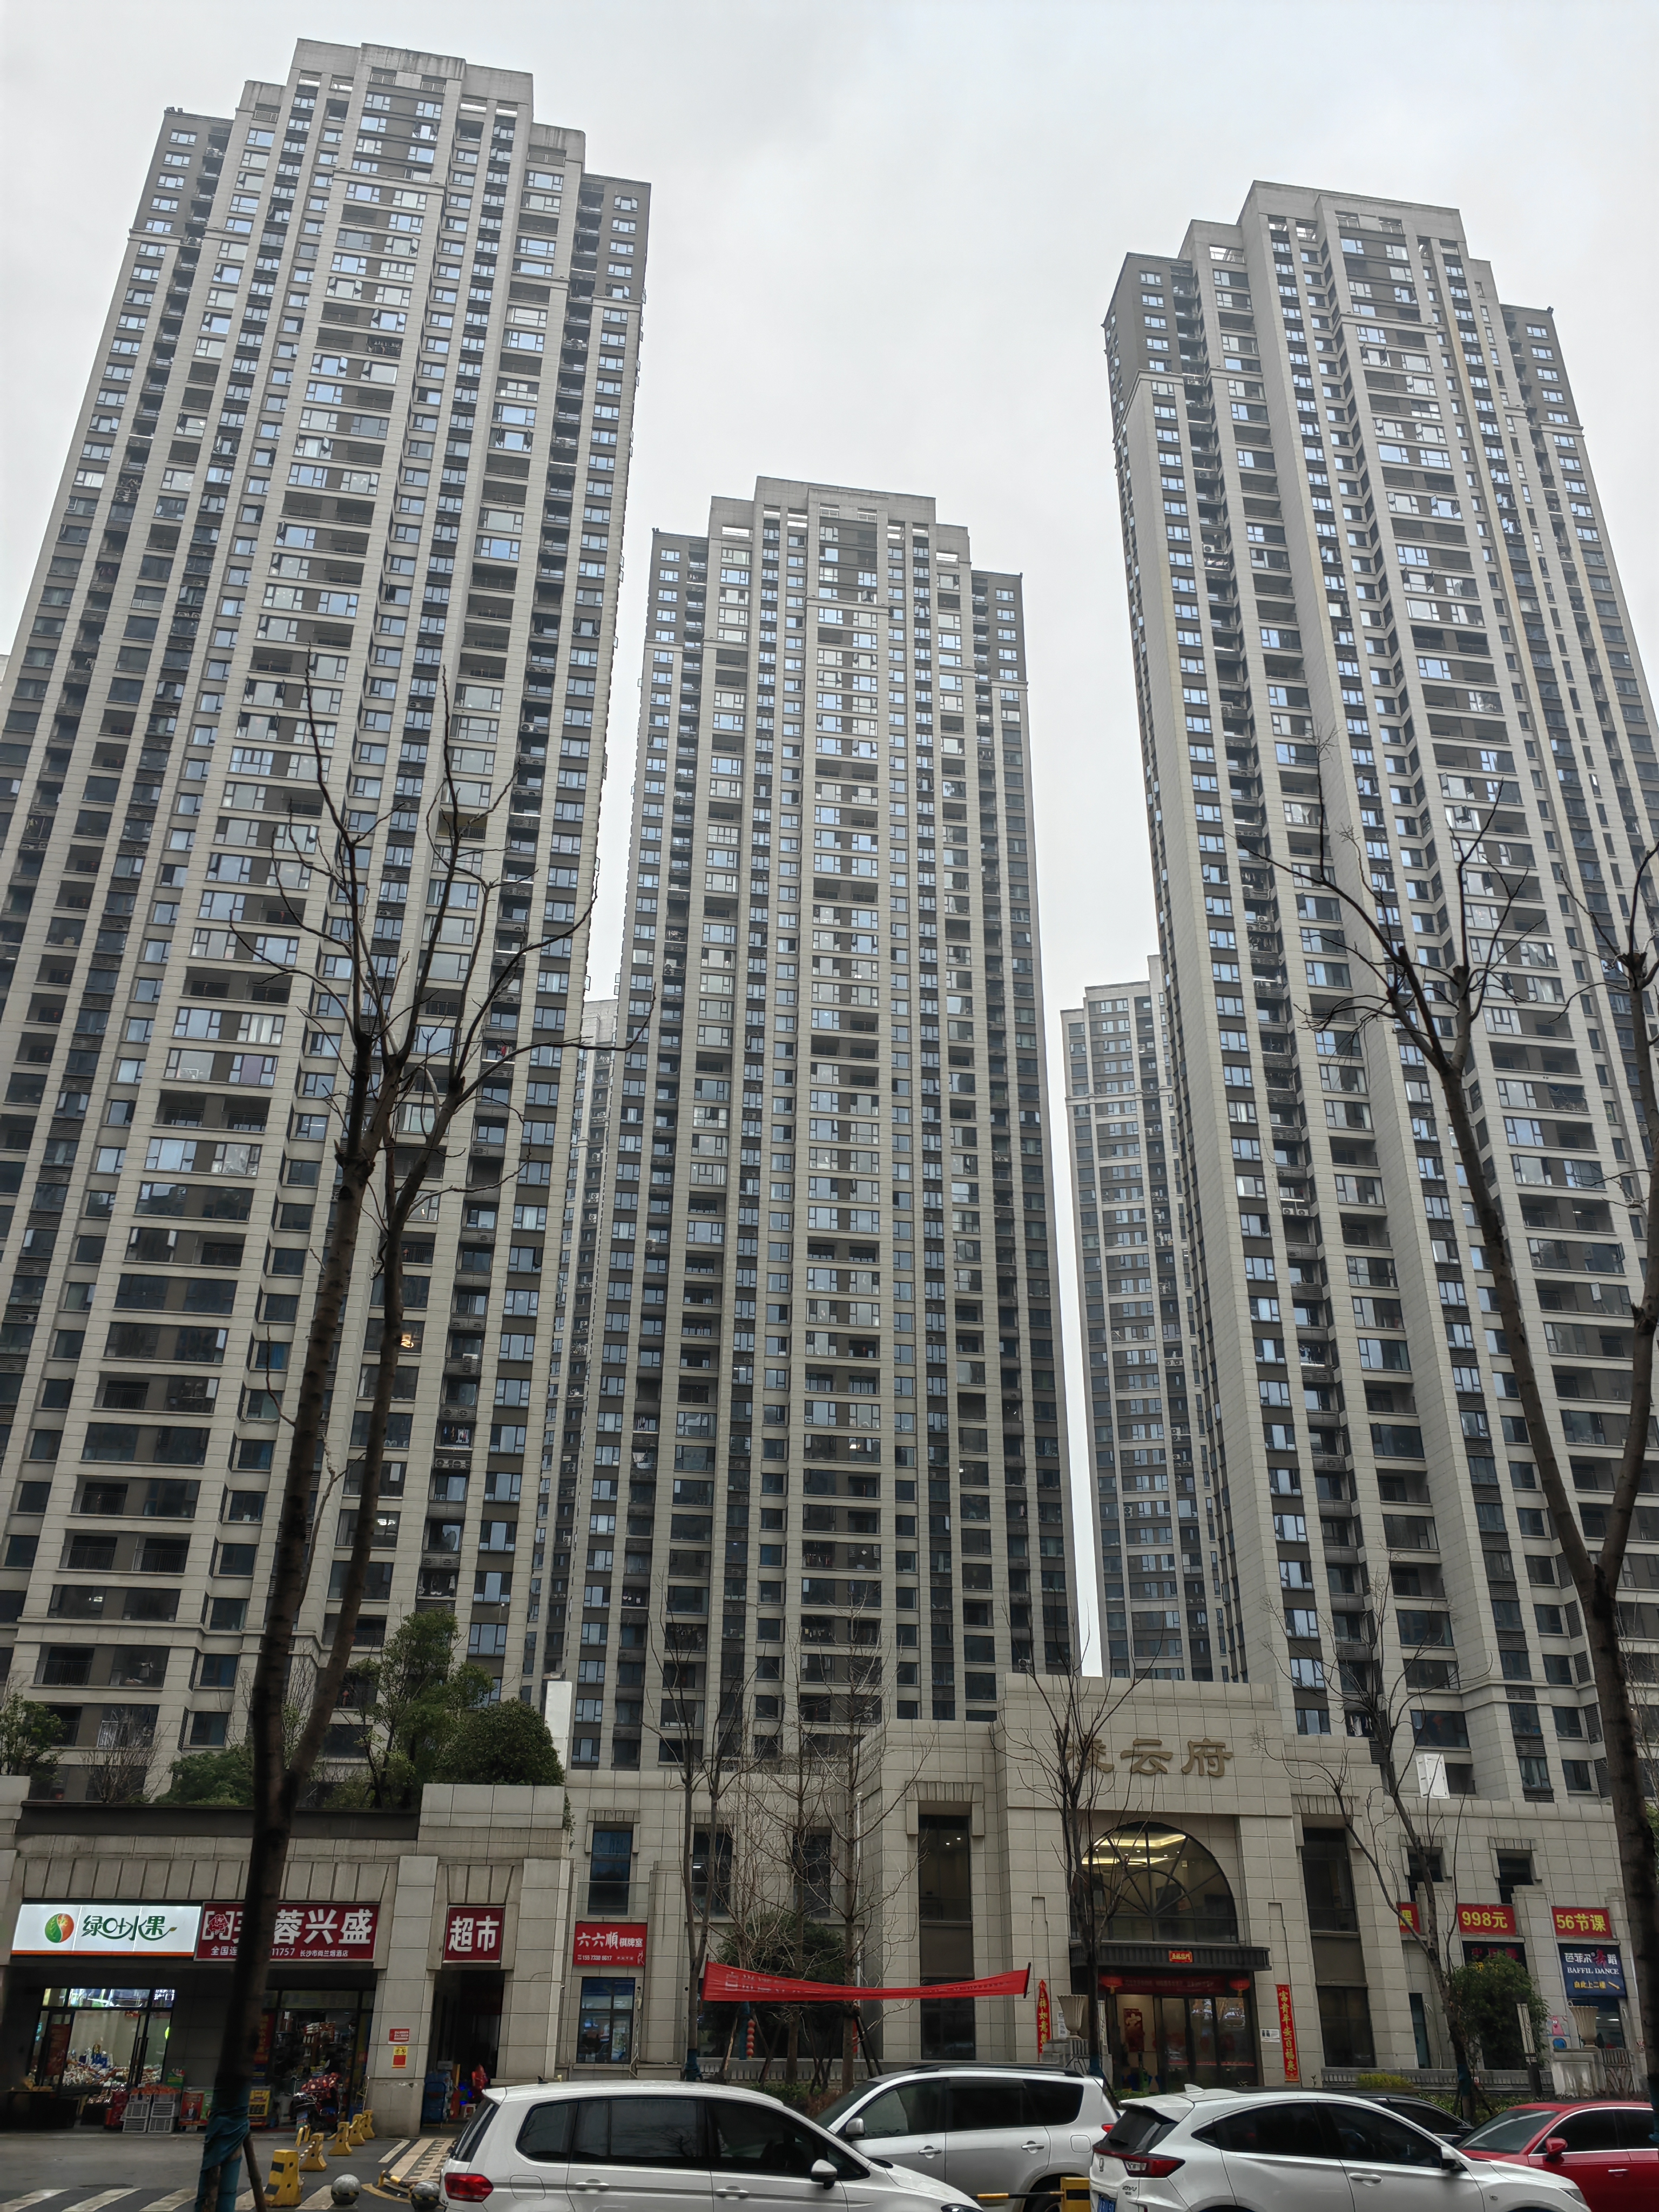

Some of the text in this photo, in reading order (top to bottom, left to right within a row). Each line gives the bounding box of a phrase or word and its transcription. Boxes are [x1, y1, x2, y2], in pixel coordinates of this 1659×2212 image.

[81, 1915, 167, 1940] 绿叶水果
[1462, 1911, 1508, 1928] 998元
[1556, 1913, 1606, 1932] 56节课
[448, 1915, 500, 1952] 超市
